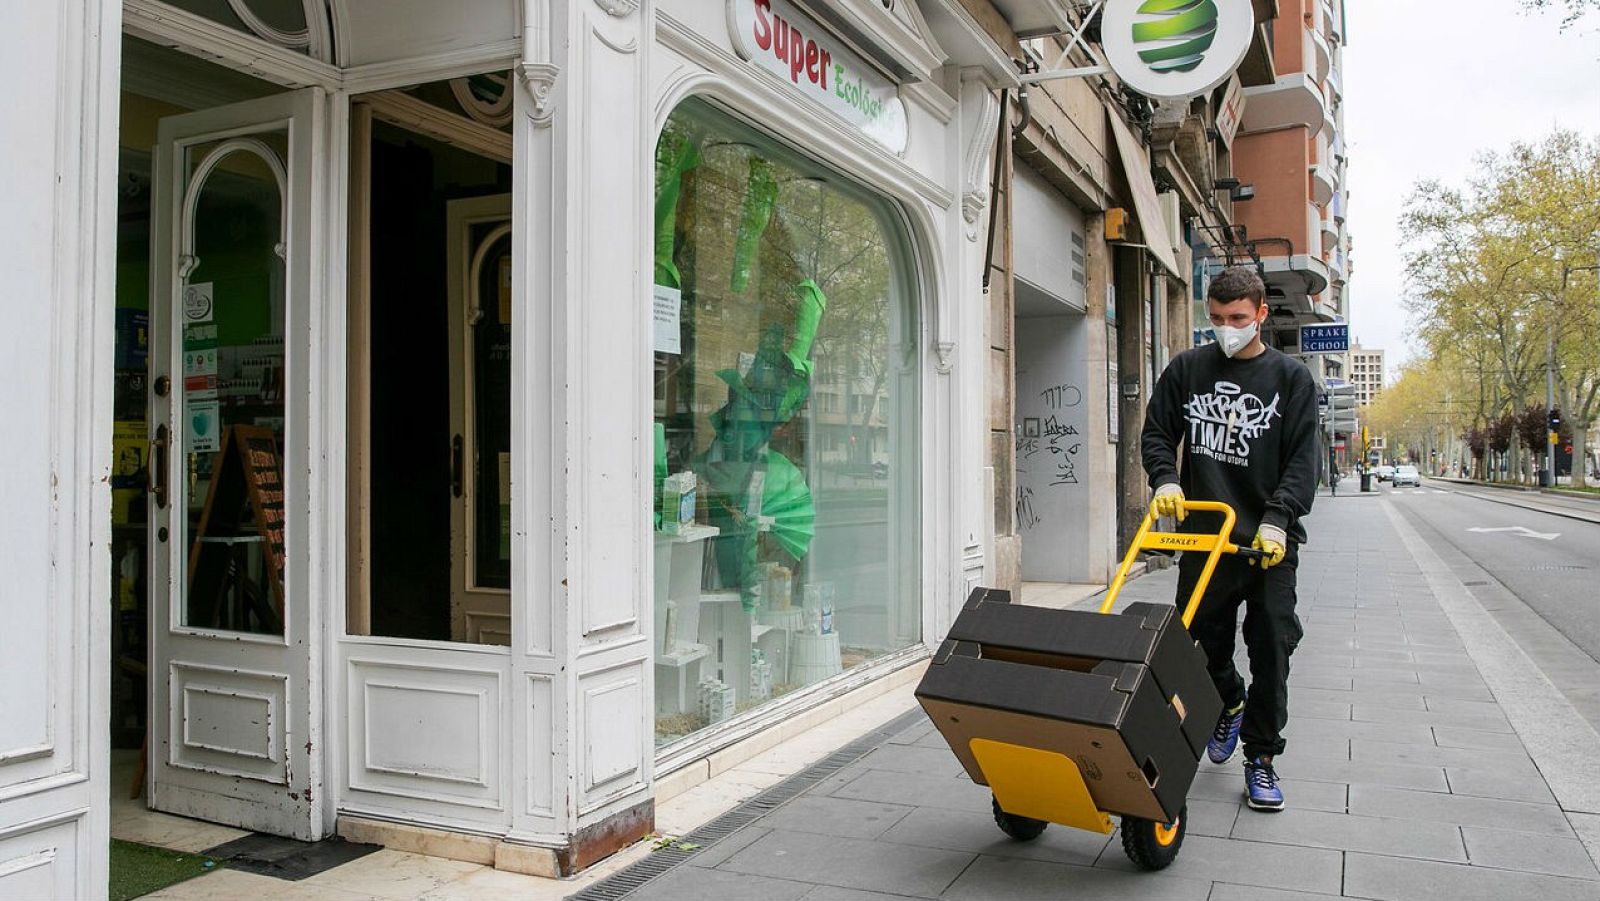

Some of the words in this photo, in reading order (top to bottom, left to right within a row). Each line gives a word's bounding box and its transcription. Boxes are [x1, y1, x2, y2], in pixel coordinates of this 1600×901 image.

[753, 0, 831, 90] Super
[1303, 328, 1348, 338] SPRAKE
[1303, 341, 1348, 350] SCHOOL
[1190, 418, 1250, 457] TIMES
